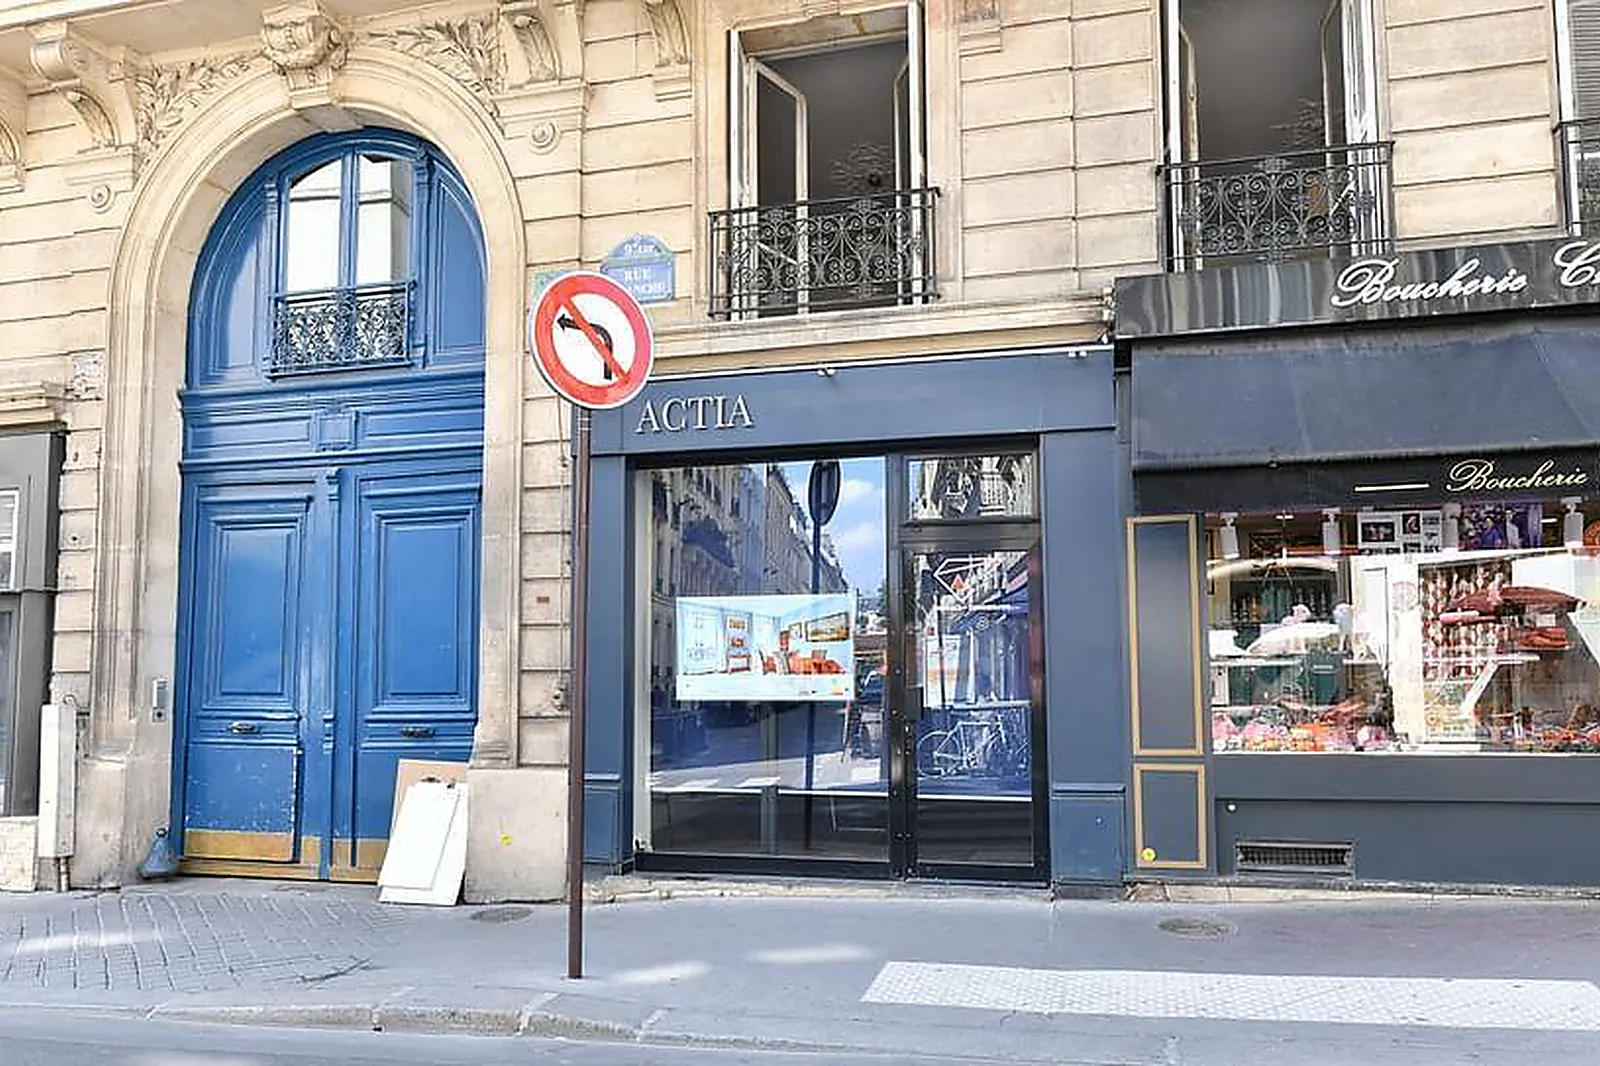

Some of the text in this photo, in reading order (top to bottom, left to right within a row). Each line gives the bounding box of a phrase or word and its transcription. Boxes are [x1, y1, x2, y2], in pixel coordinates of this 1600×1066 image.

[624, 267, 652, 281] RUE
[1331, 241, 1600, 307] Boucherie C
[635, 394, 754, 434] ACTIA
[1446, 458, 1589, 492] Boucherie
